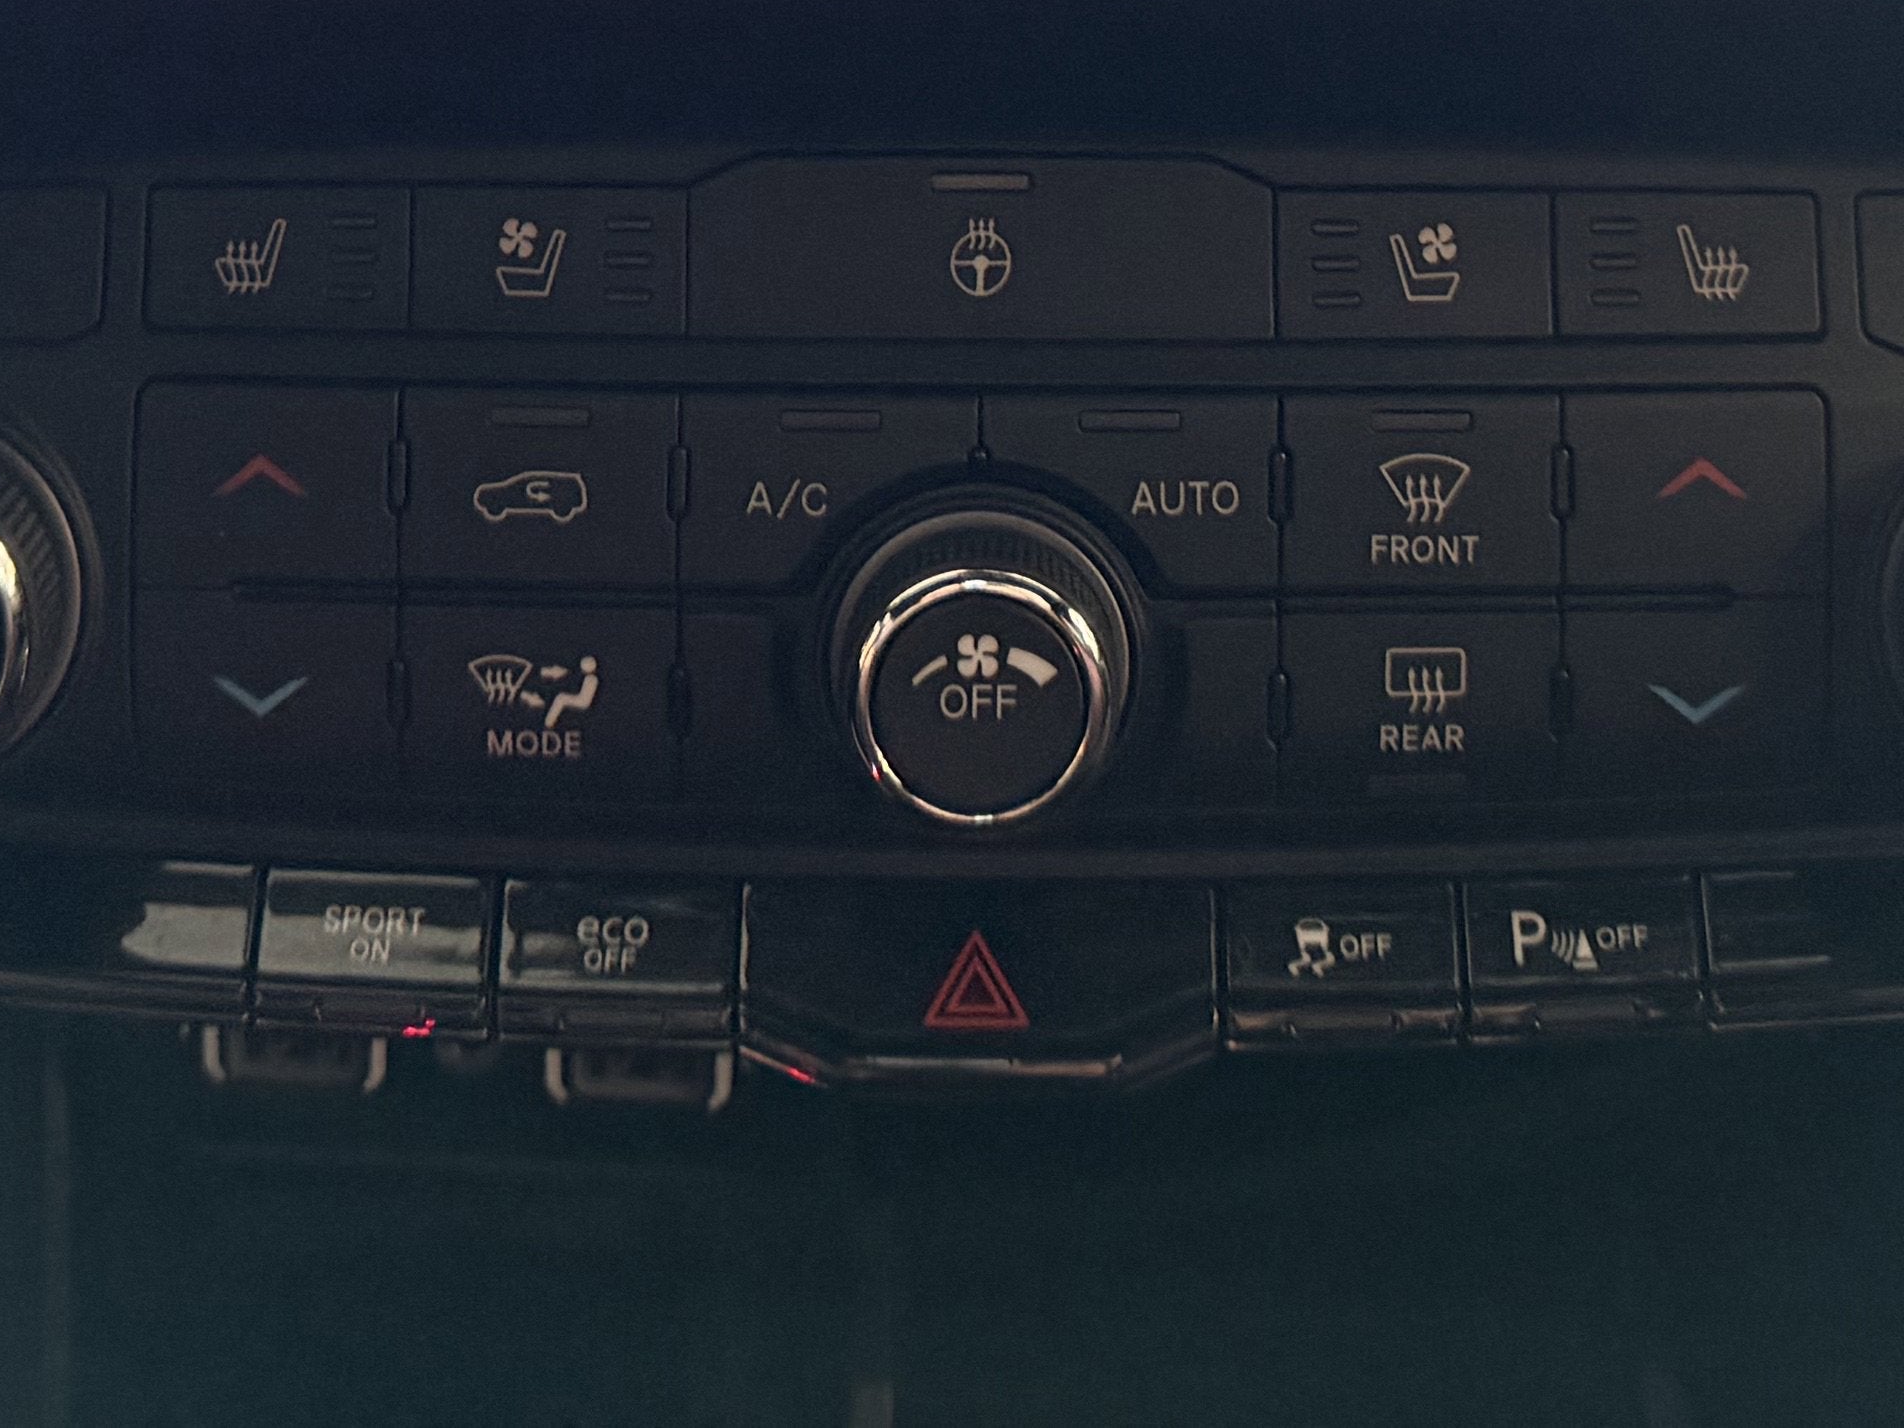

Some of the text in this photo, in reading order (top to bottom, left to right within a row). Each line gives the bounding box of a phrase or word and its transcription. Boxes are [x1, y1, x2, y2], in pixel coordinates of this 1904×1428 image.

[745, 480, 830, 521] A/C
[1130, 479, 1241, 518] AUTO
[1369, 534, 1480, 565] FRONT
[938, 683, 1019, 721] OFF
[485, 729, 582, 758] MODE
[1378, 724, 1466, 753] REAR
[322, 903, 428, 938] SPORT
[576, 915, 650, 946] eco
[347, 937, 392, 967] ON
[1339, 931, 1394, 963] OFF
[1595, 922, 1649, 954] OFF
[582, 947, 638, 976] OFF
